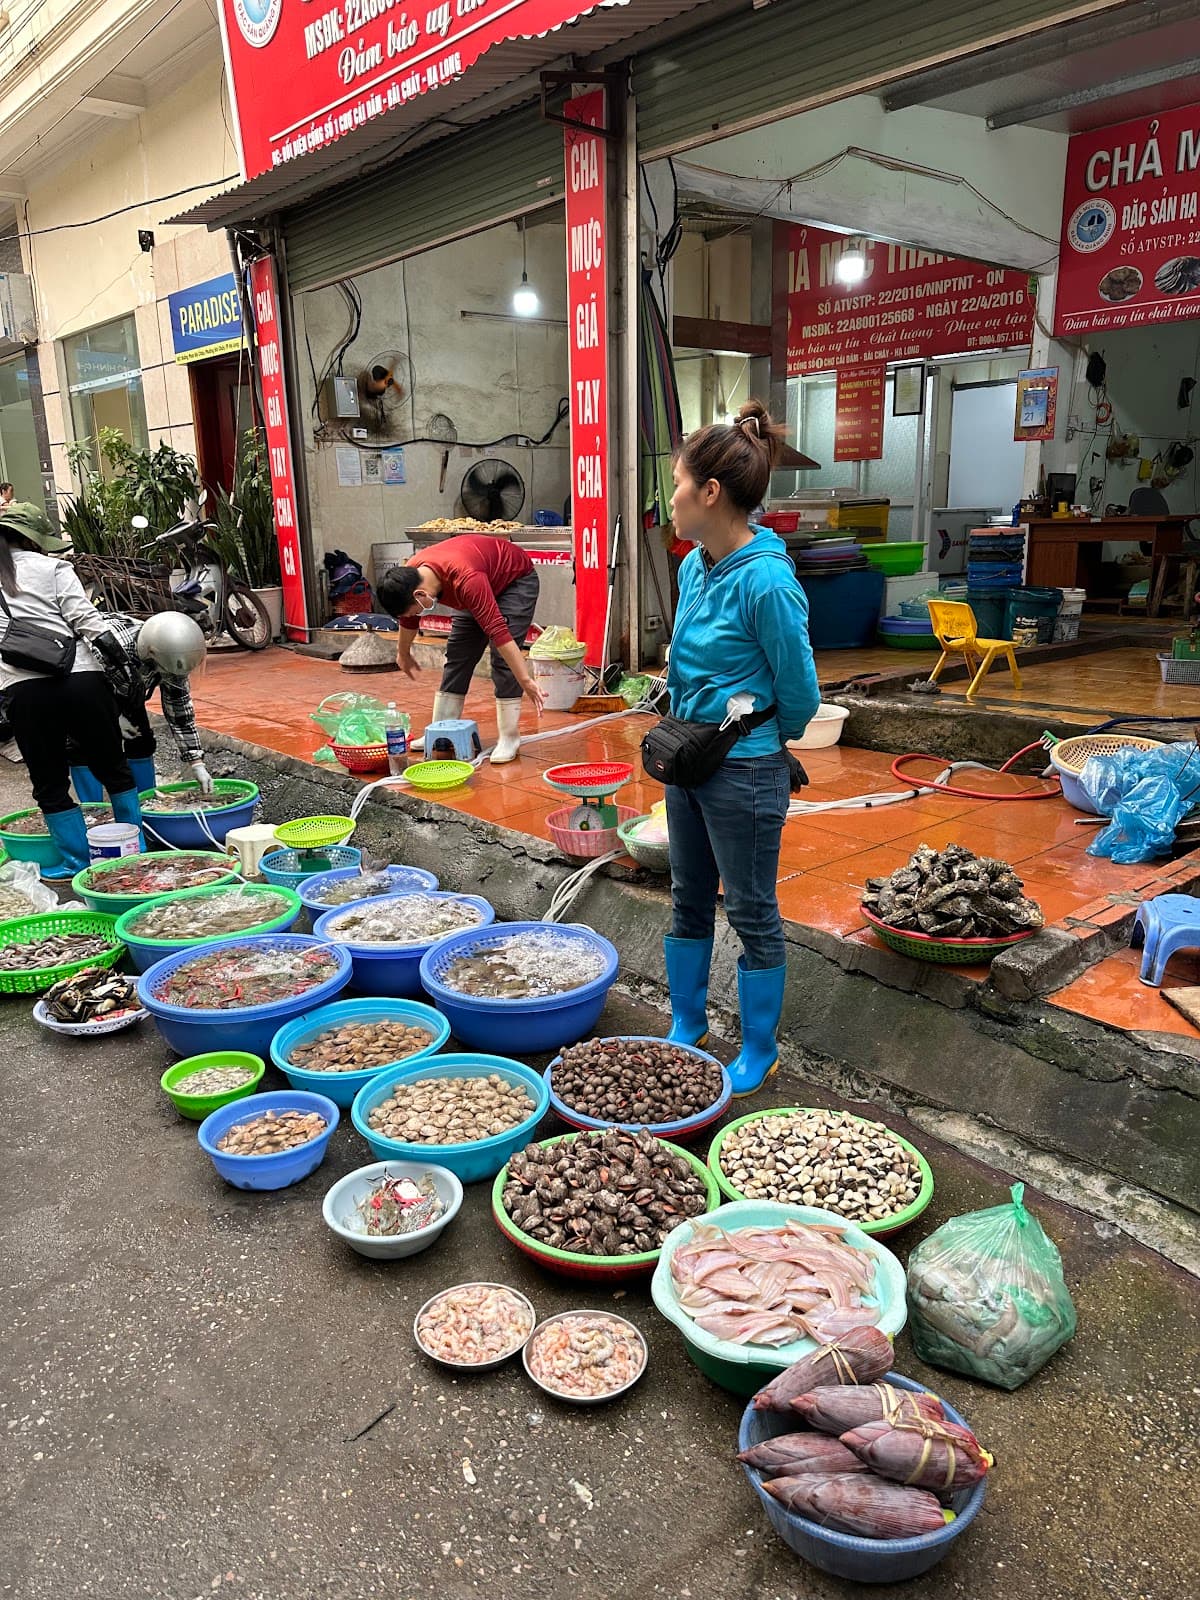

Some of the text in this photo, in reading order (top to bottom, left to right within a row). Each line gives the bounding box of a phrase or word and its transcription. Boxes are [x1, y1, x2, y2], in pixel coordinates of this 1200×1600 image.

[304, 7, 346, 59] MSĐK:
[338, 1, 453, 84] Đảm bảo uy
[439, 52, 462, 80] LONG
[1086, 119, 1163, 192] CHẢ
[1121, 186, 1198, 234] ĐẶC SẢN HẠ
[571, 216, 602, 281] MỰC
[1120, 236, 1135, 255] SỐ
[1137, 233, 1186, 253] ATVSTP:
[179, 289, 241, 337] PARADISE
[802, 324, 834, 339] MSĐK:
[836, 307, 915, 333] 22A800125668
[926, 299, 958, 318] NGÀY
[961, 289, 1024, 313] 22/4/2016
[818, 297, 831, 316] SỐ
[834, 294, 876, 313] ATVSTP:
[878, 275, 975, 305] 22/2016/NNPTNT
[986, 269, 1005, 287] QN
[1130, 308, 1145, 322] tín
[1148, 303, 1172, 319] chất
[576, 292, 599, 349] GIÃ
[870, 327, 897, 345] Chất
[900, 327, 934, 342] lượng
[945, 319, 982, 336] Phục
[904, 344, 920, 355] LONG
[256, 275, 297, 576] CHẢ MỰC GIÃ TAY CHẢ CÁ
[576, 379, 600, 425] TAY
[577, 435, 603, 498] CHẢ
[582, 518, 599, 569] CÁ
